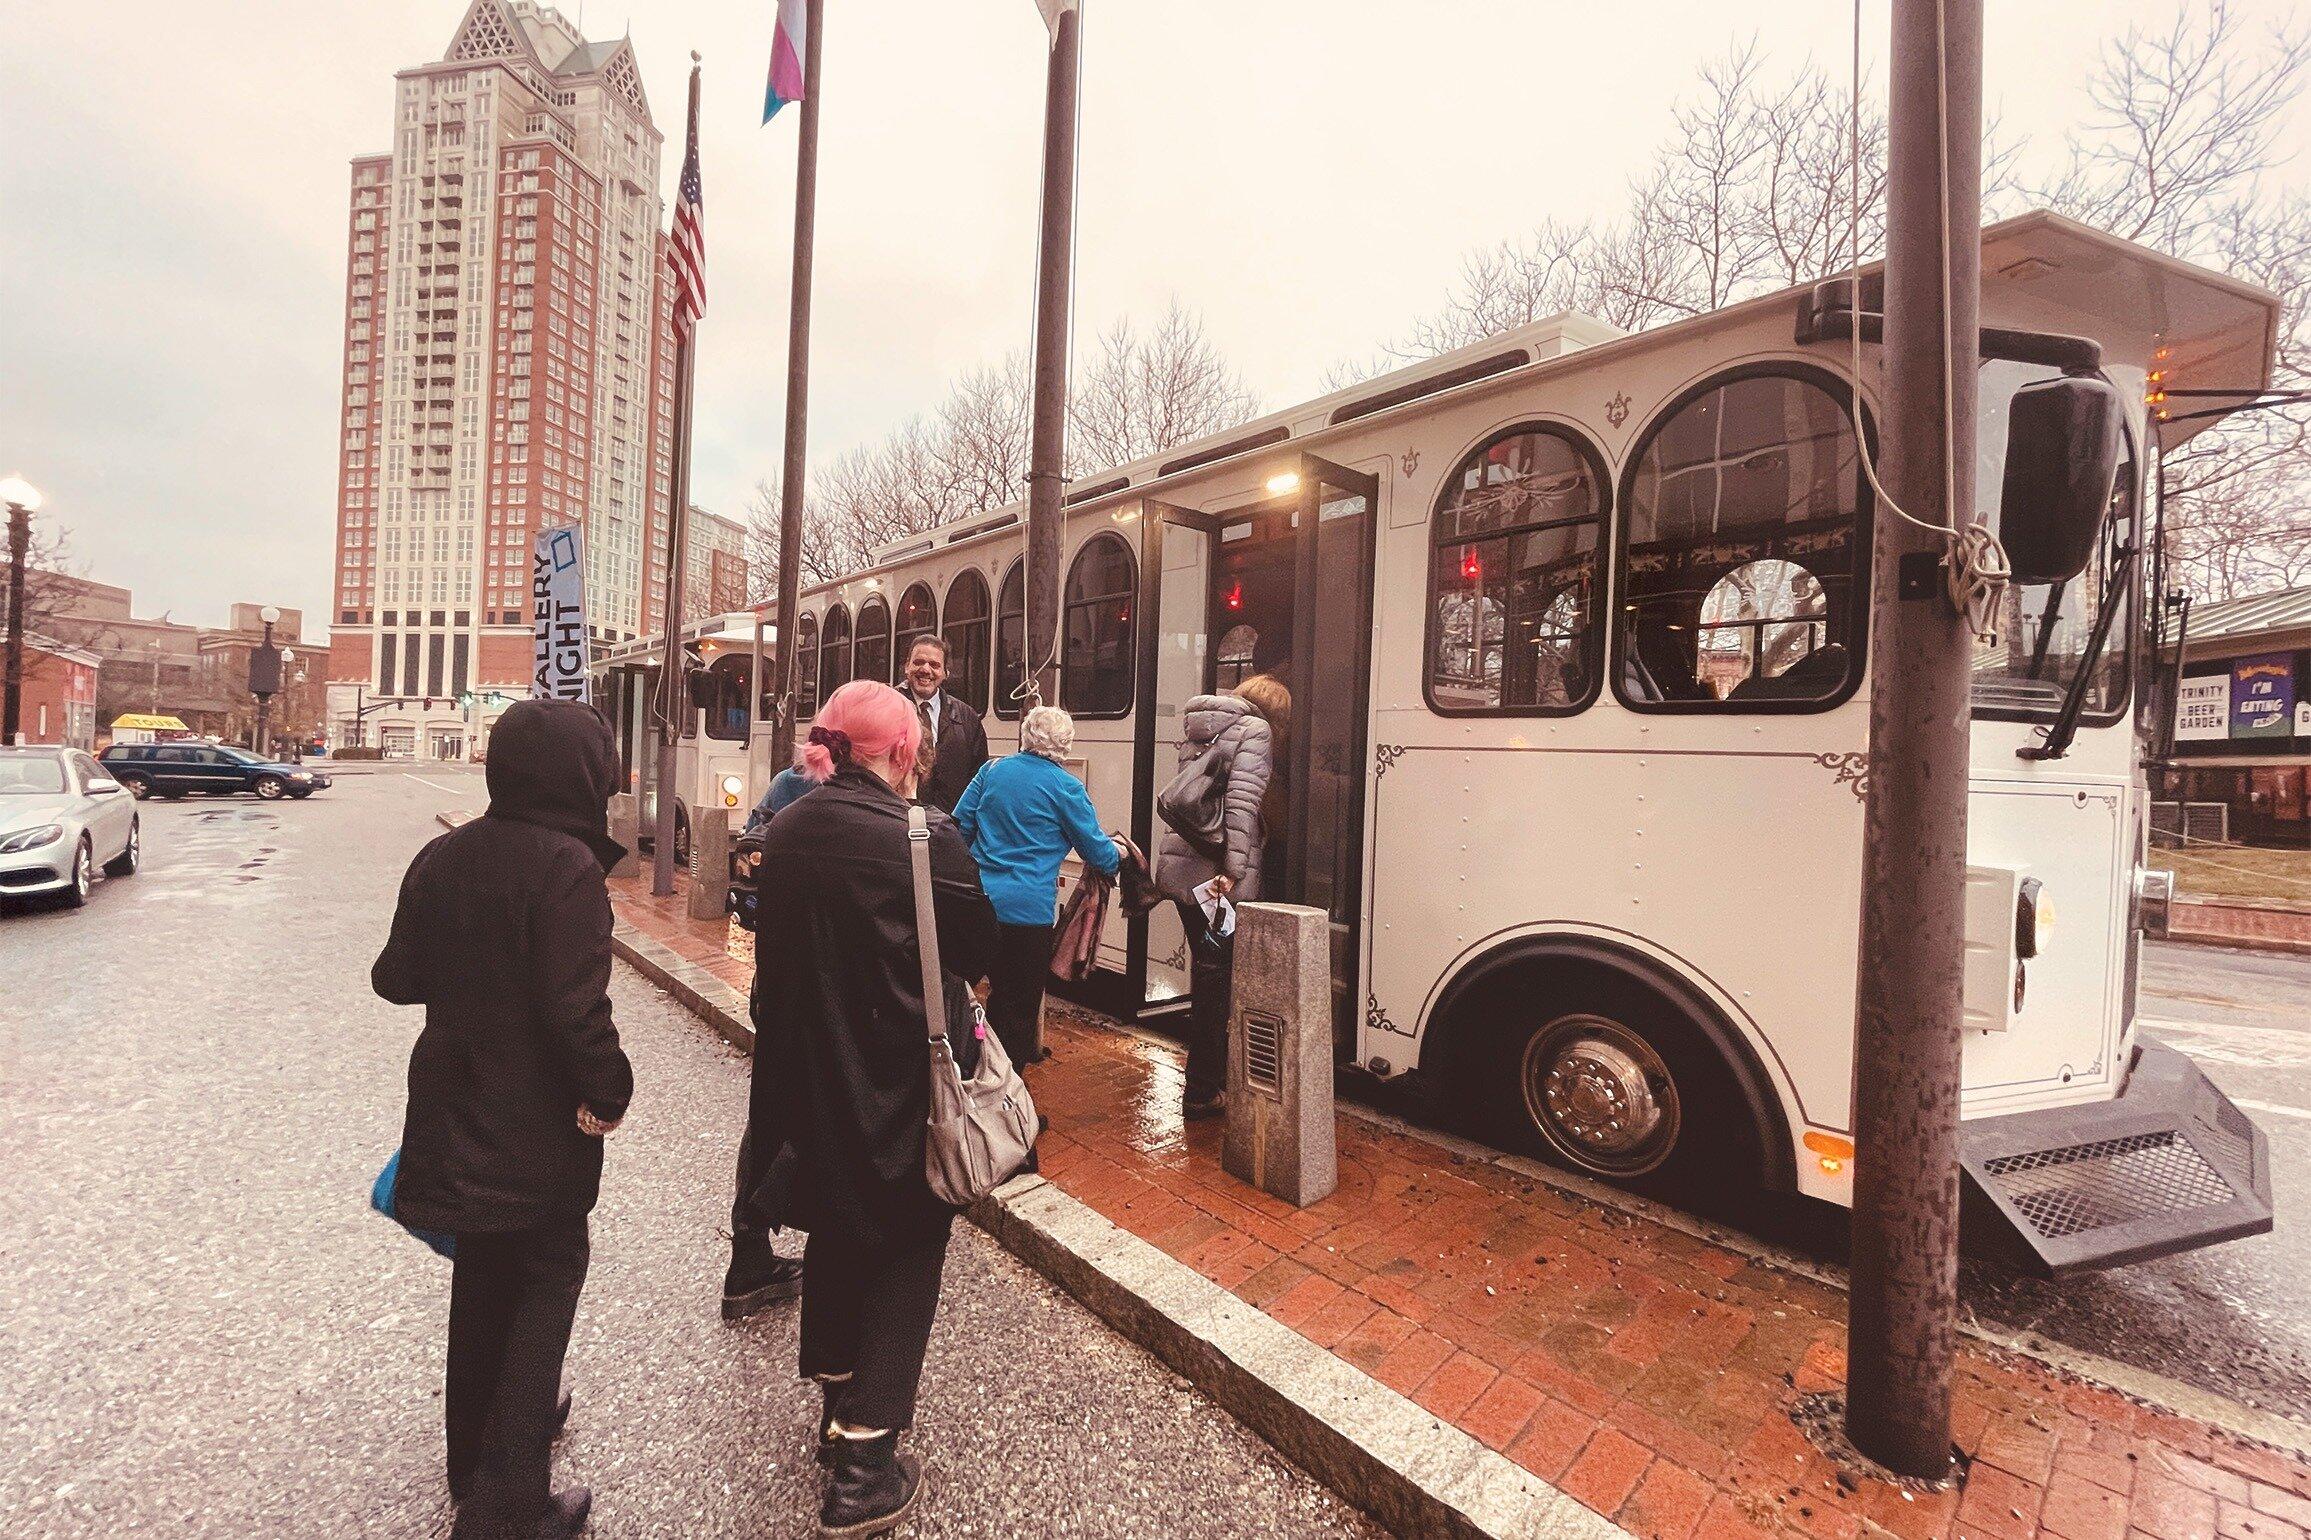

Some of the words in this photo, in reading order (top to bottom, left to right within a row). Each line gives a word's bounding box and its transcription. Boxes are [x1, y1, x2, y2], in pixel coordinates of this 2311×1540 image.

[534, 554, 551, 699] ALLERY
[2181, 685, 2223, 699] TRINITY
[2187, 704, 2215, 716] BEER
[2180, 716, 2223, 729] GARDEN
